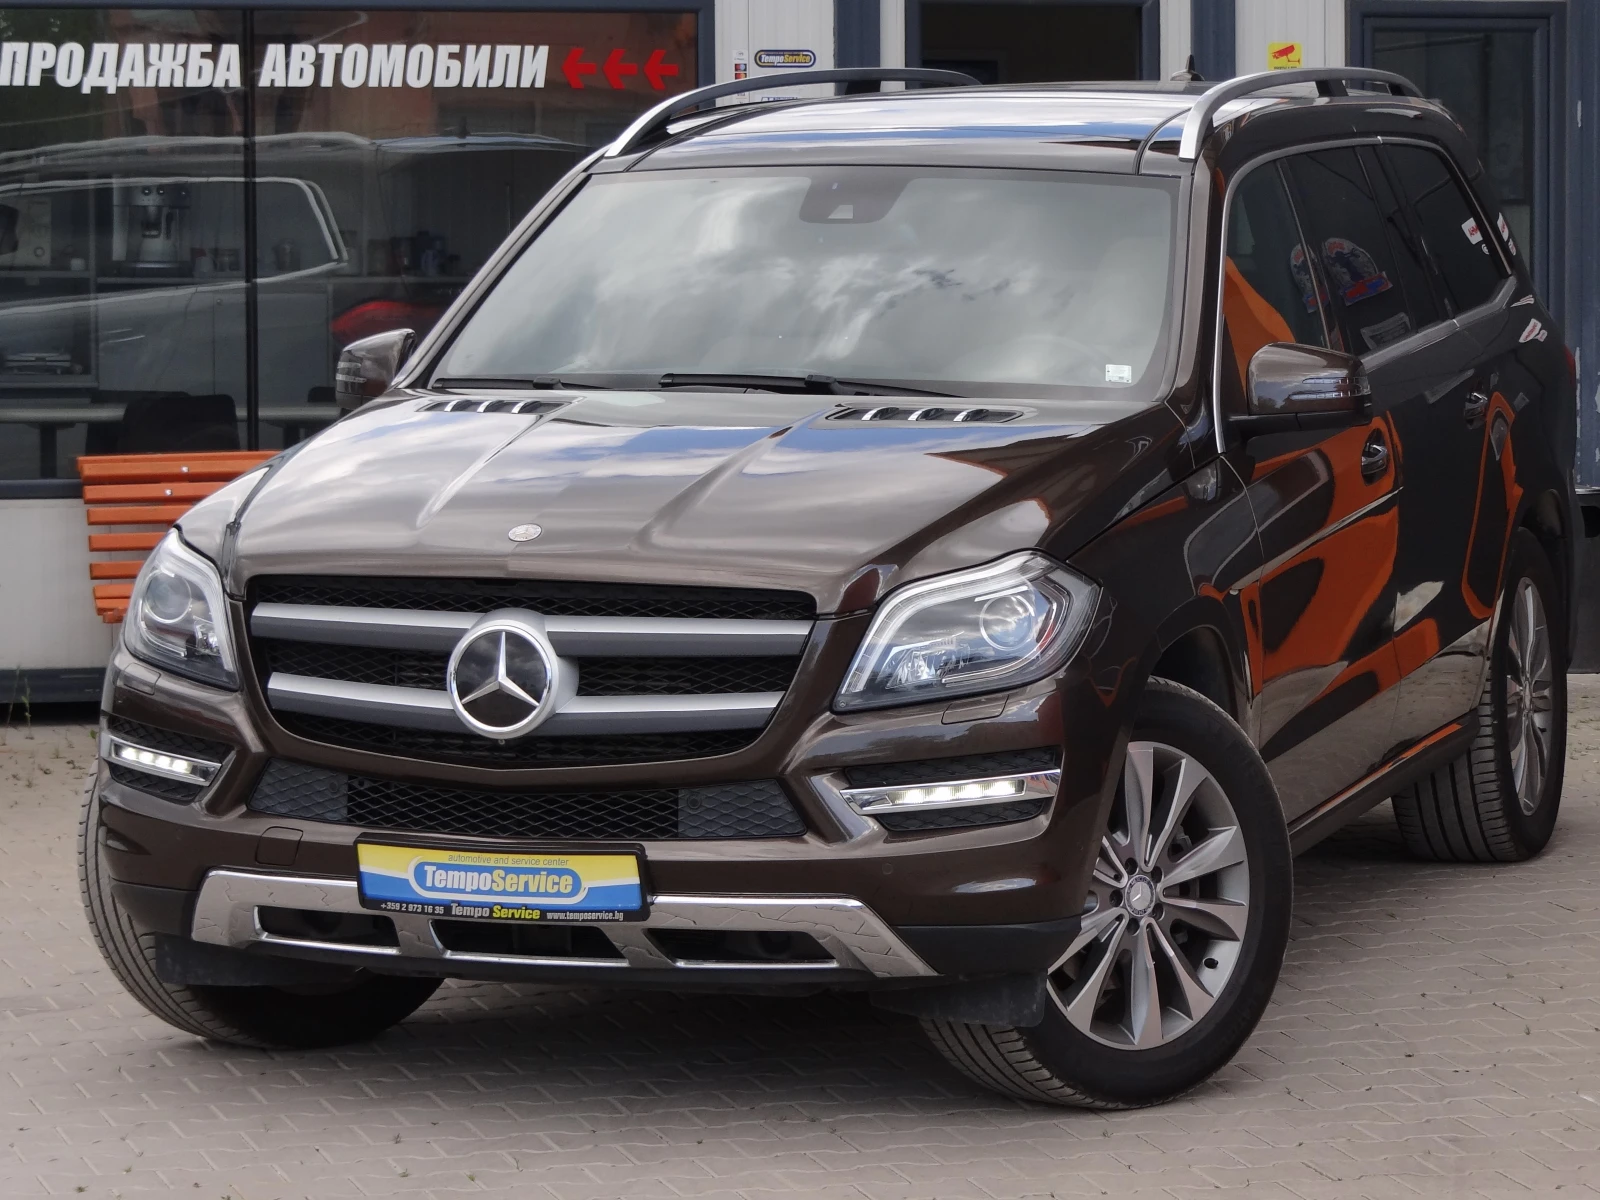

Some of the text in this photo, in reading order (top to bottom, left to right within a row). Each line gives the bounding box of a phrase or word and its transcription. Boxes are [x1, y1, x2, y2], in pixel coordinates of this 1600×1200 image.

[761, 54, 811, 66] TempoService
[0, 42, 550, 94] ПРОДАЖБА АВТОМОБИЛИ
[448, 854, 569, 866] automotive and service center
[424, 865, 573, 894] TempoService
[380, 902, 444, 914] +359 2 973 16 35
[451, 903, 541, 919] Tempo Service
[546, 911, 624, 921] www.temposervice.bg
